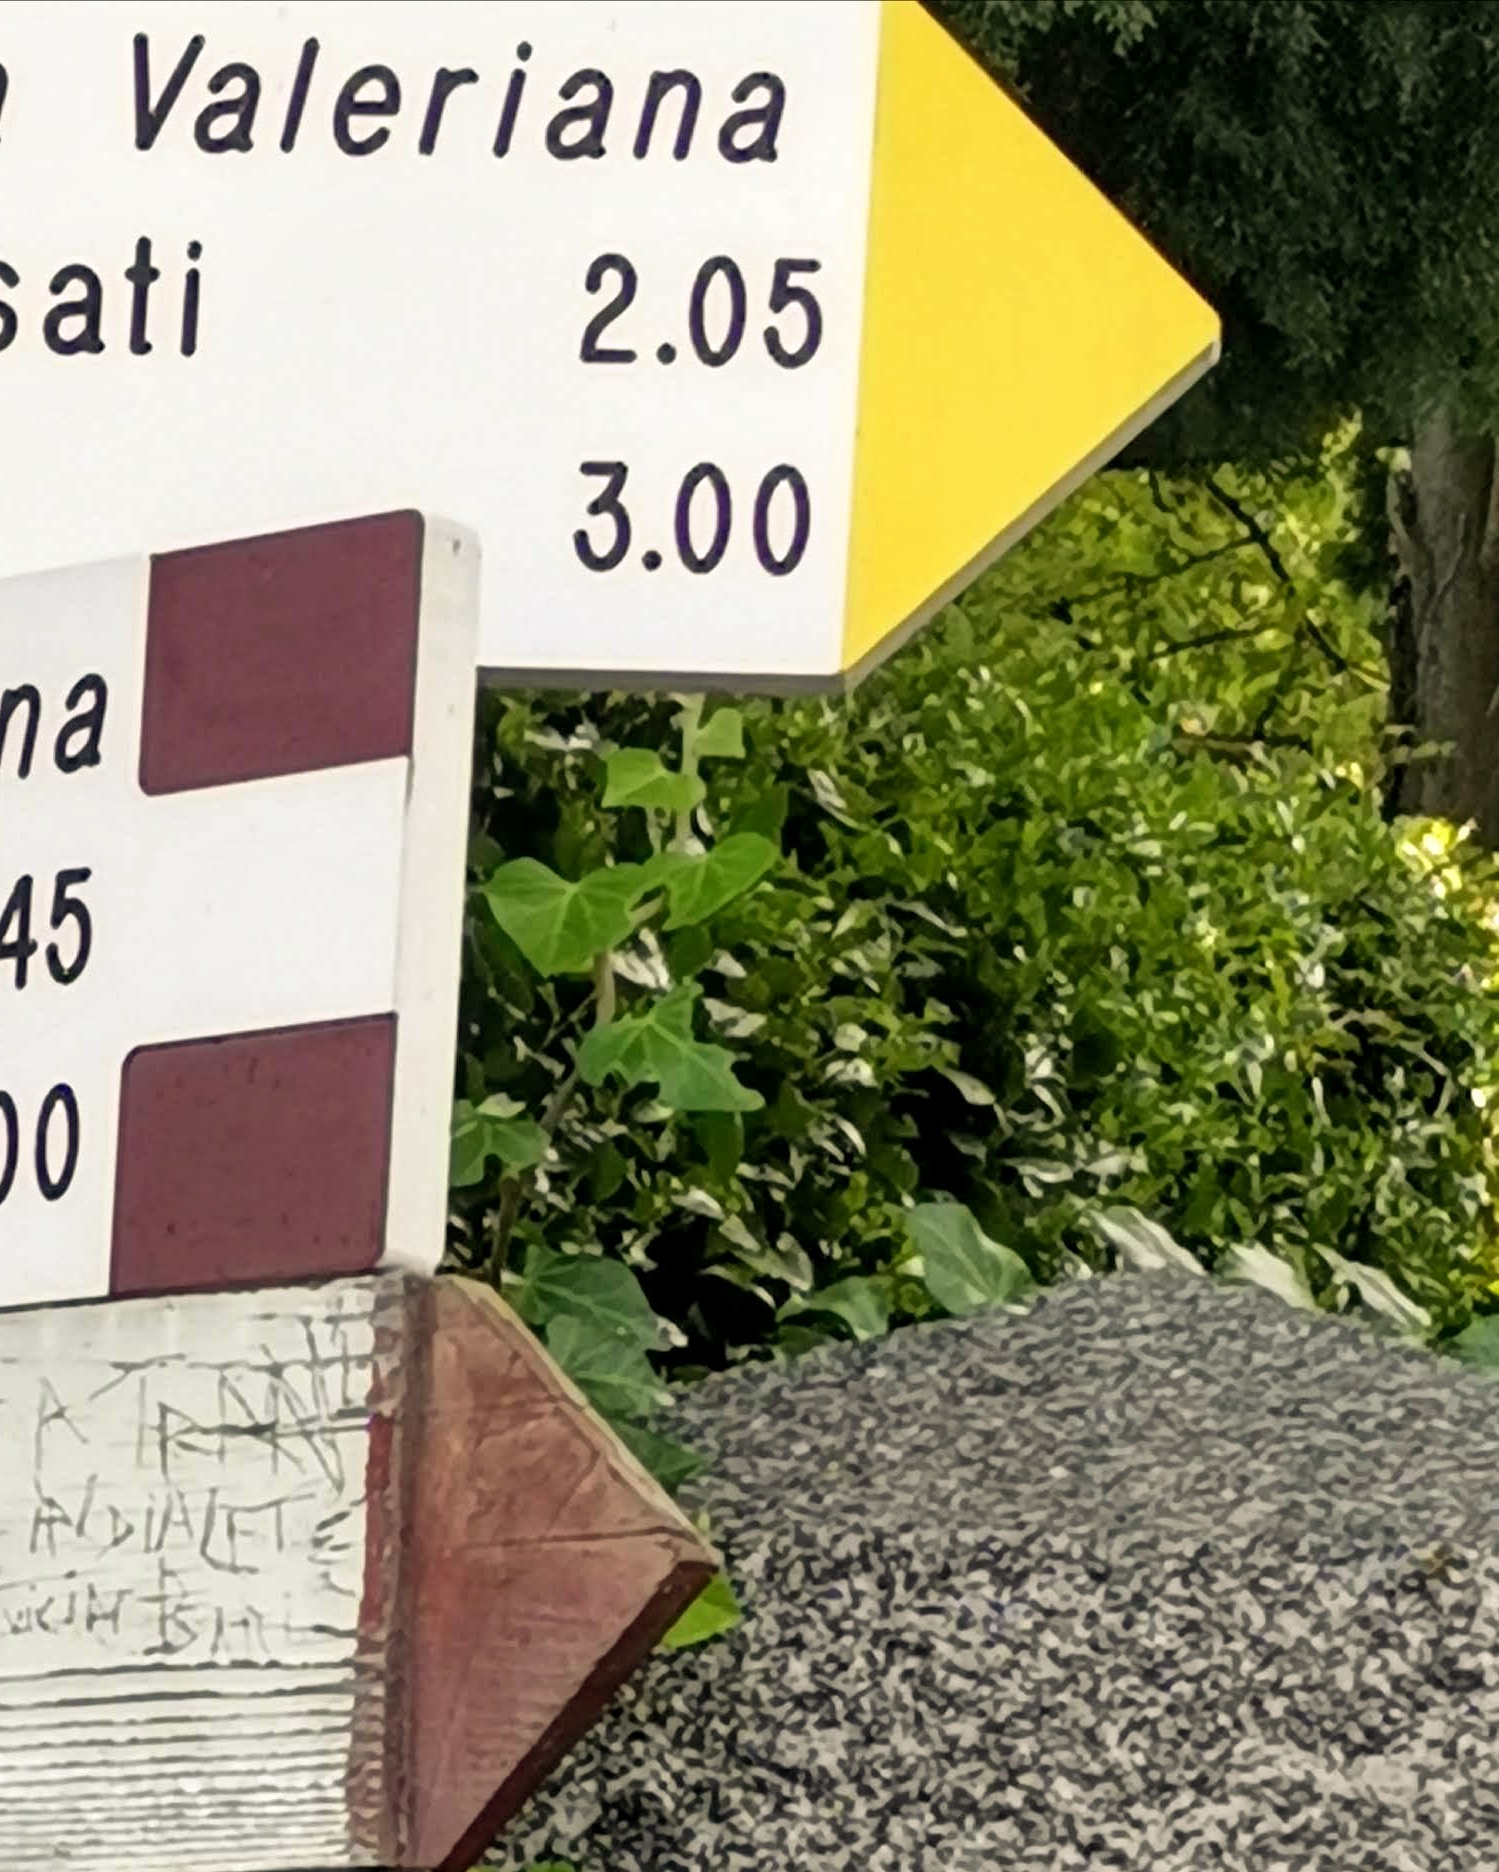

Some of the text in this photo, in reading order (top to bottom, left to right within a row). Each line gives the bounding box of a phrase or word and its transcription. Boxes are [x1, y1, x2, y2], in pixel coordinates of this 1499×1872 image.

[133, 33, 786, 164] Valeriana
[580, 253, 822, 369] 2.05
[573, 461, 811, 576] 3.00
